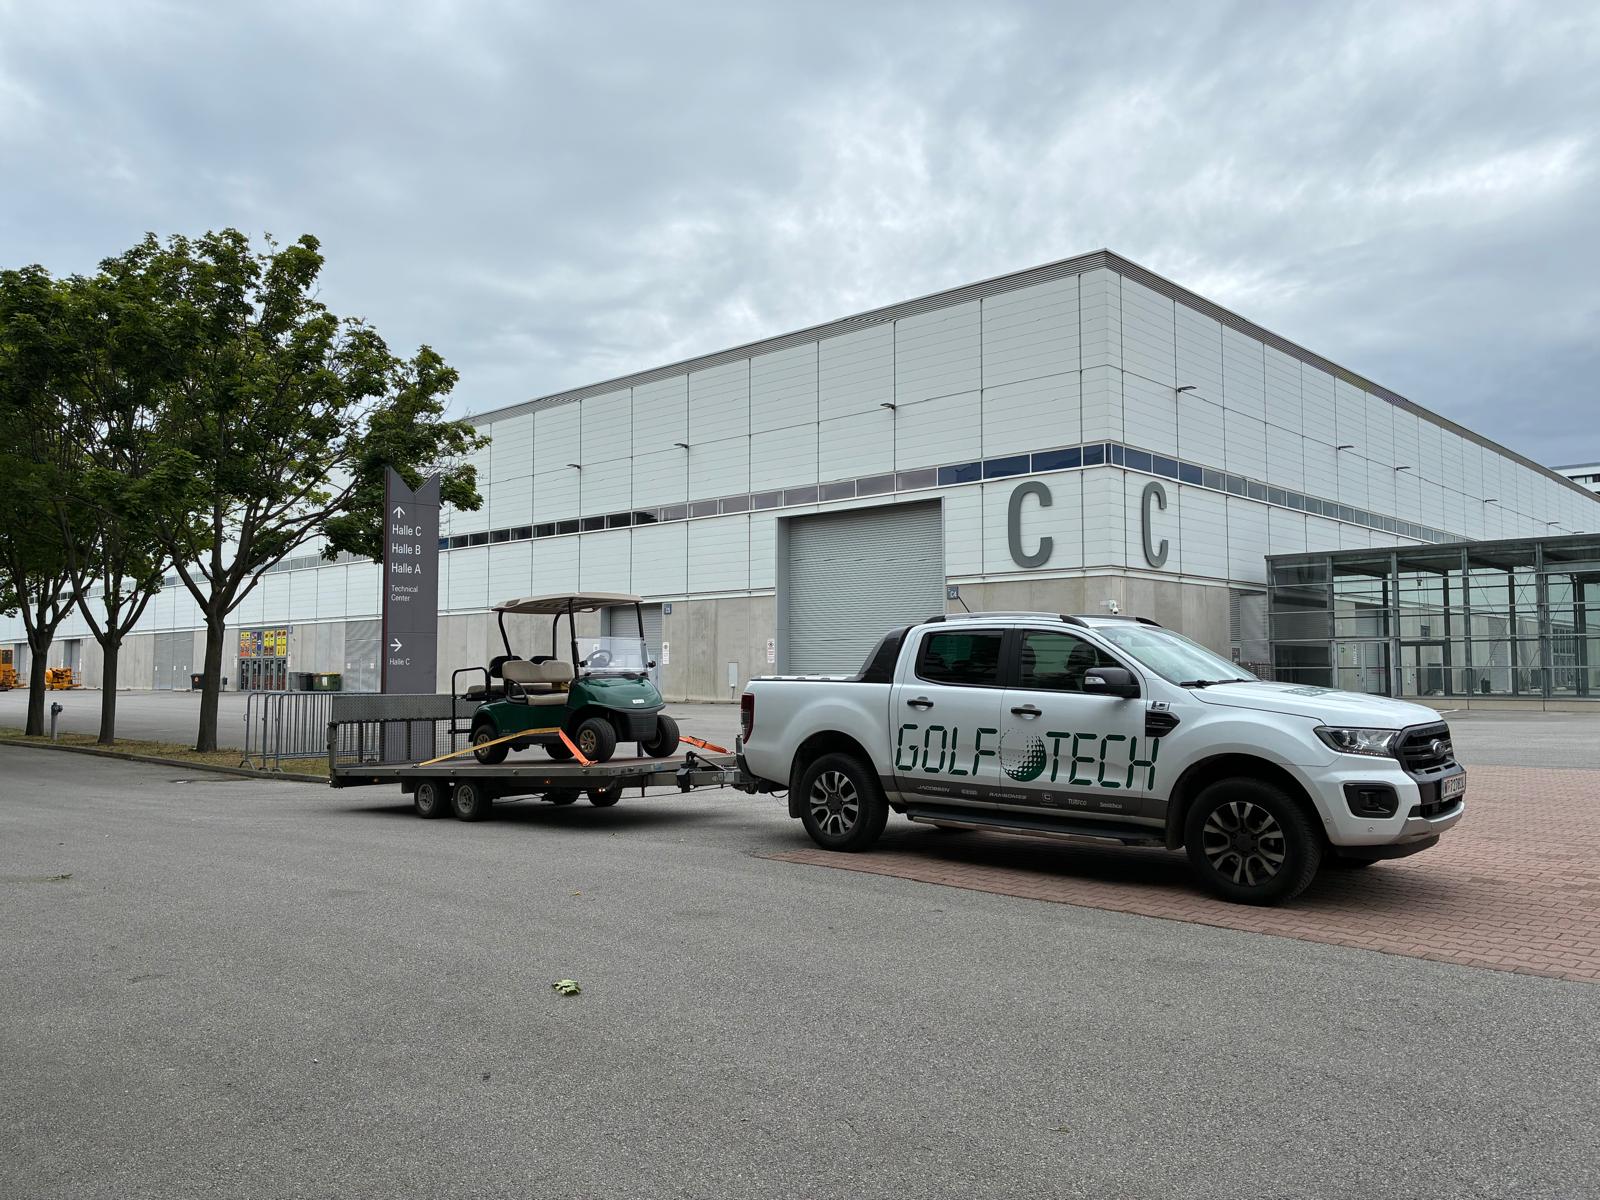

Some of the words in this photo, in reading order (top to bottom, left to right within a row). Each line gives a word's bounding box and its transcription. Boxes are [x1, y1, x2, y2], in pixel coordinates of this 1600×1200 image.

[392, 523, 413, 536] Halle
[415, 526, 422, 537] C
[1007, 480, 1053, 569] C
[1142, 480, 1169, 569] C
[391, 542, 413, 555] Halle
[415, 544, 421, 555] B
[391, 562, 413, 574] Halle
[414, 563, 421, 575] A
[391, 584, 418, 593] Technical
[390, 593, 411, 602] Center
[389, 657, 404, 666] Halle
[405, 658, 411, 666] C
[895, 723, 998, 776] GOLF
[1046, 731, 1160, 791] TECH
